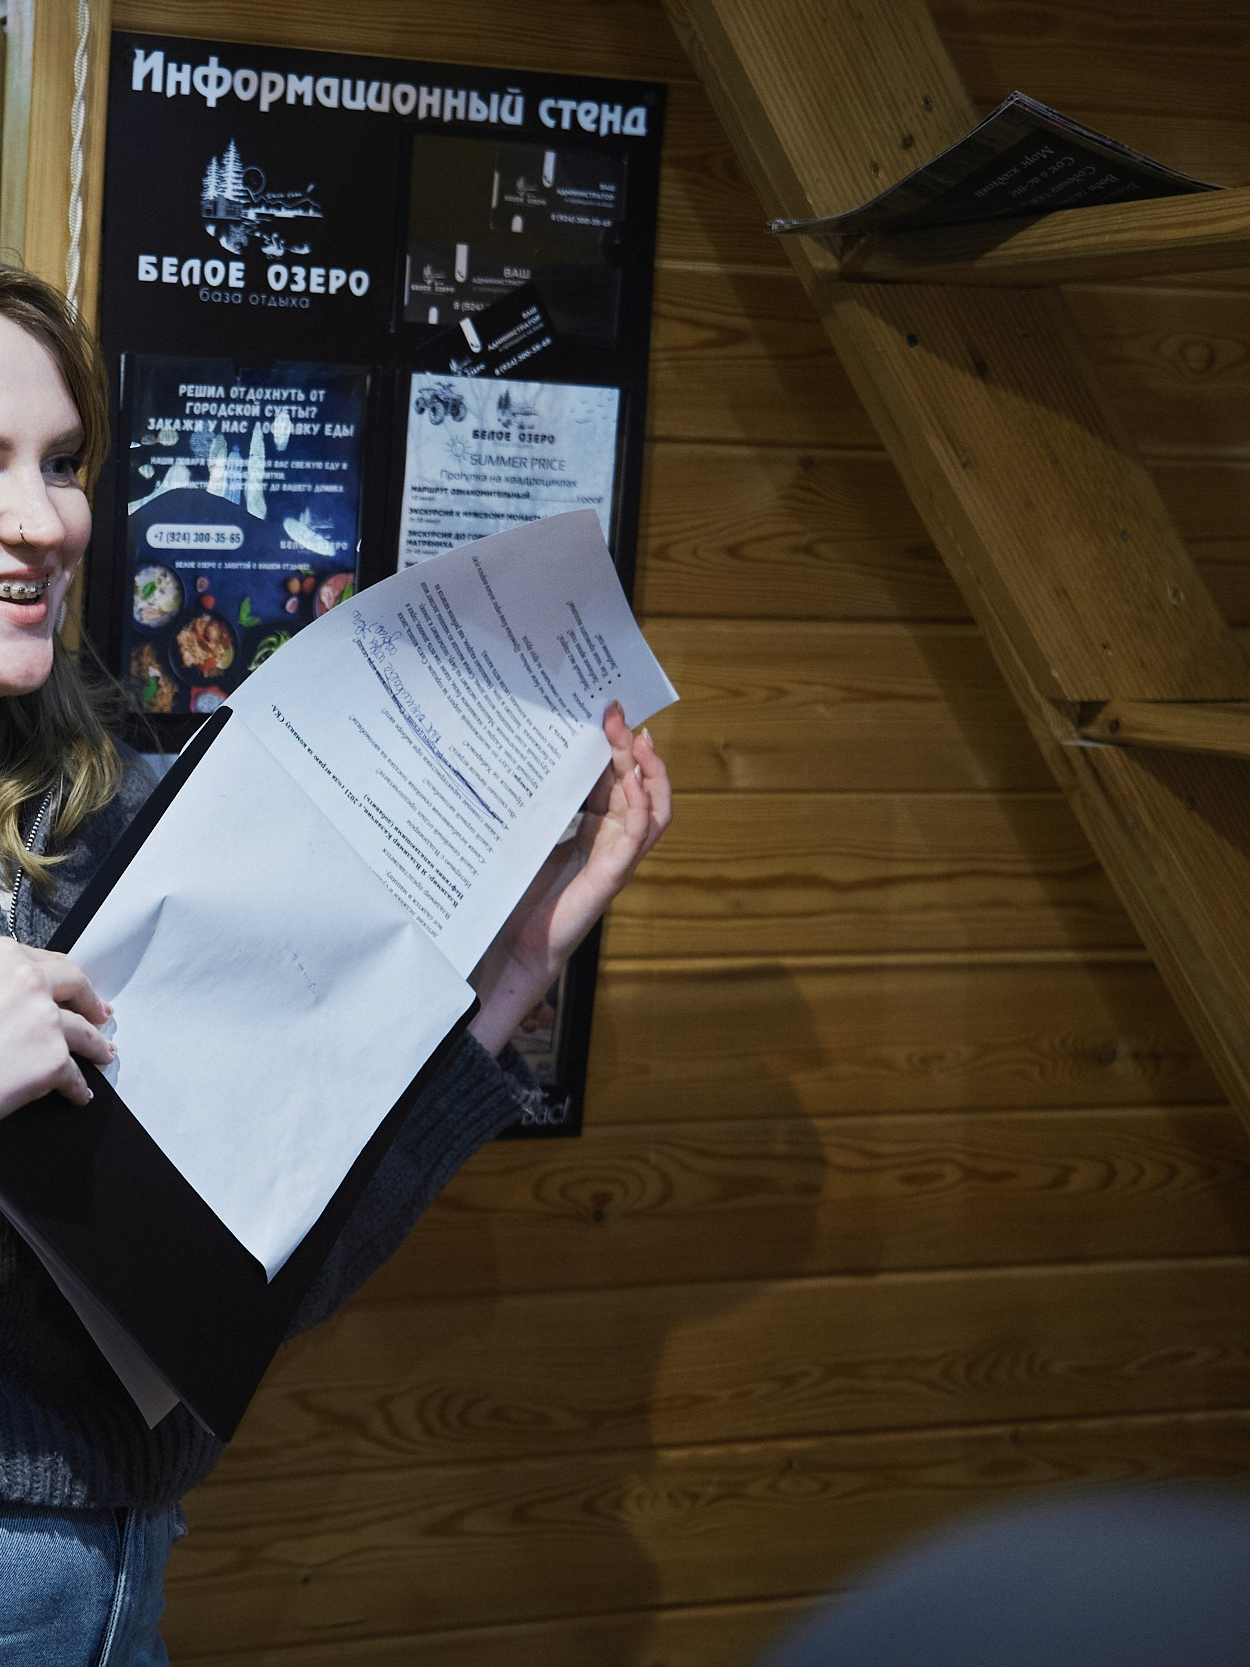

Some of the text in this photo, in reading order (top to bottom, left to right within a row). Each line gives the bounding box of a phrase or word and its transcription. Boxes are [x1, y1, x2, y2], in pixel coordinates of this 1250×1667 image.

[132, 49, 647, 136] Информационный стенд
[138, 255, 370, 297] БЕЛОЕ ОЗЕРО
[504, 267, 531, 279] ВАШ
[199, 288, 310, 309] база отдыха
[453, 302, 459, 310] 8
[179, 384, 326, 402] РЕШИЛ ОТДОХНУТЬ ОТ
[185, 401, 318, 418] ГОРОДСКОЙ СУЕТЫ?
[148, 418, 354, 438] ЗАКАЖИ У НАС ЕДЫ
[472, 429, 556, 444] БЕЛОЕ ОЗЕРО
[470, 454, 566, 472] SUMMER PRICE
[440, 469, 578, 488] Прогулка на квадроциклах
[153, 532, 241, 544] +7 (924) 300-35-65
[379, 707, 395, 724] авто?
[284, 720, 307, 748] команду
[552, 728, 569, 749] Часть
[312, 754, 332, 776] играю
[447, 744, 469, 766] играть?
[461, 738, 493, 774] Хабаровск?
[498, 757, 512, 774] Едут
[330, 774, 344, 789] года
[468, 765, 487, 786] начали
[511, 772, 533, 798] Камера:
[342, 788, 358, 805] 2021
[407, 779, 432, 807] семейная
[415, 809, 434, 829] отдых
[453, 811, 475, 833] первый
[431, 827, 460, 856] семейный
[391, 836, 421, 870] Владимир
[405, 818, 471, 889] Интервью Владимиром
[426, 873, 458, 908] Владимир:
[422, 888, 451, 920] Владимир
